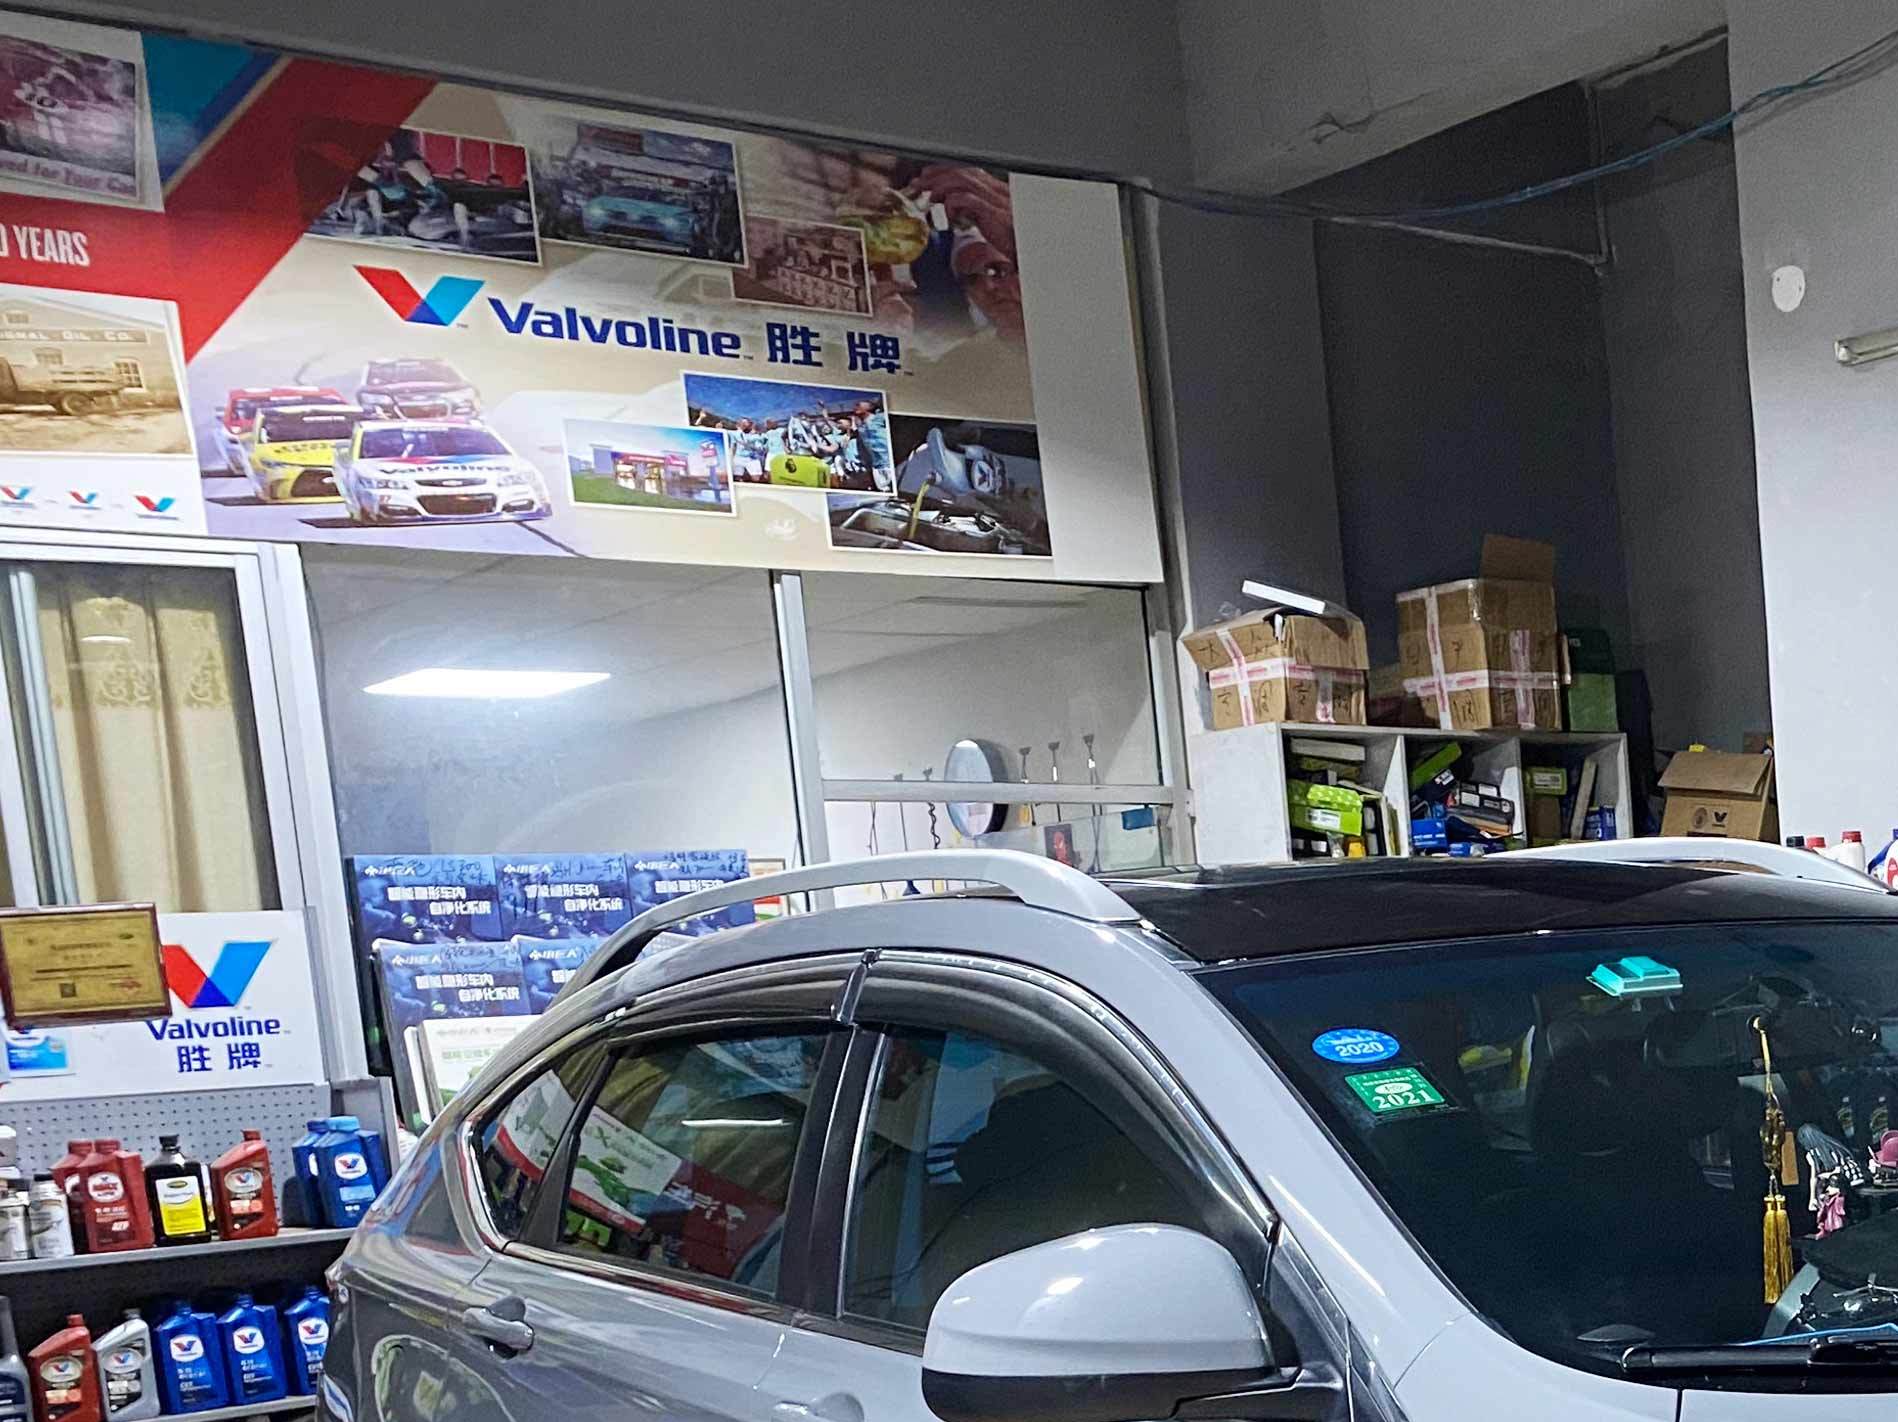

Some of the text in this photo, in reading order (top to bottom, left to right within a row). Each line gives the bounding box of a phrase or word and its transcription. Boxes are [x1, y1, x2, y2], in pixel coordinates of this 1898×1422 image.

[12, 224, 91, 267] YEARS
[487, 297, 903, 376] Valvoline 胜牌
[145, 1016, 280, 1041] Valvoline
[176, 1042, 261, 1073] 胜牌
[1335, 1041, 1384, 1057] 2020
[1372, 1090, 1435, 1109] 2021
